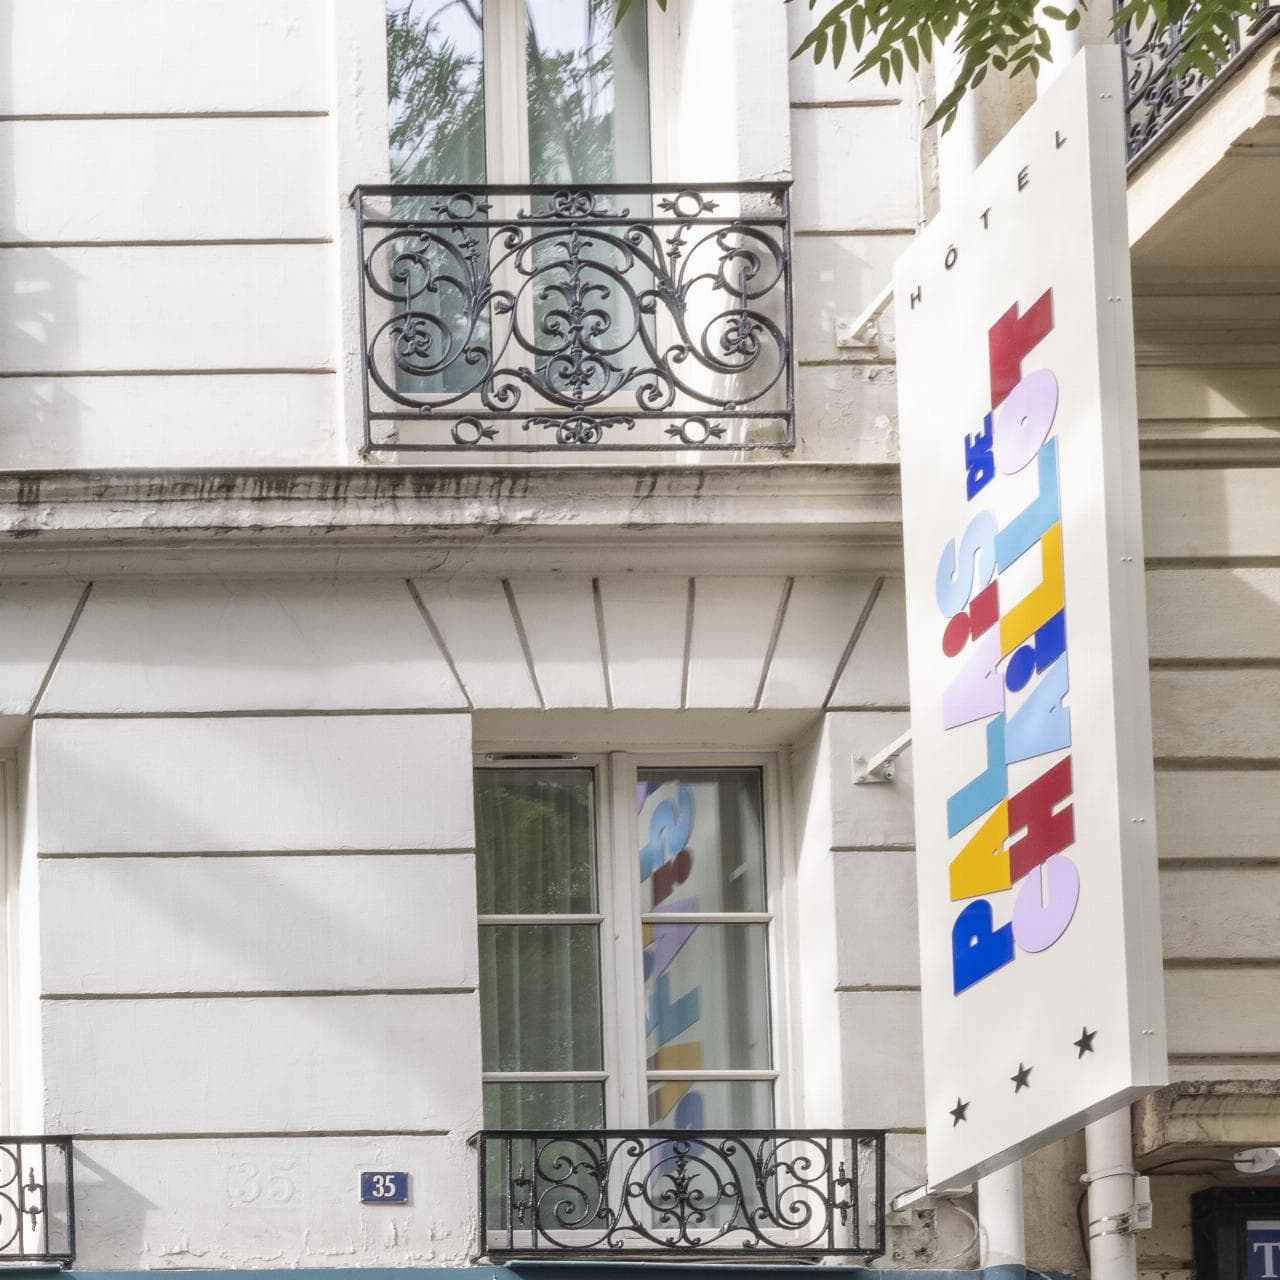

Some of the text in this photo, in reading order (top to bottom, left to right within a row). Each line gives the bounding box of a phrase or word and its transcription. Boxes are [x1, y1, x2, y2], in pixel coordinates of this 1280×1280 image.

[910, 130, 1067, 310] HÔTEL
[964, 410, 996, 502] DE
[372, 1174, 396, 1198] 35
